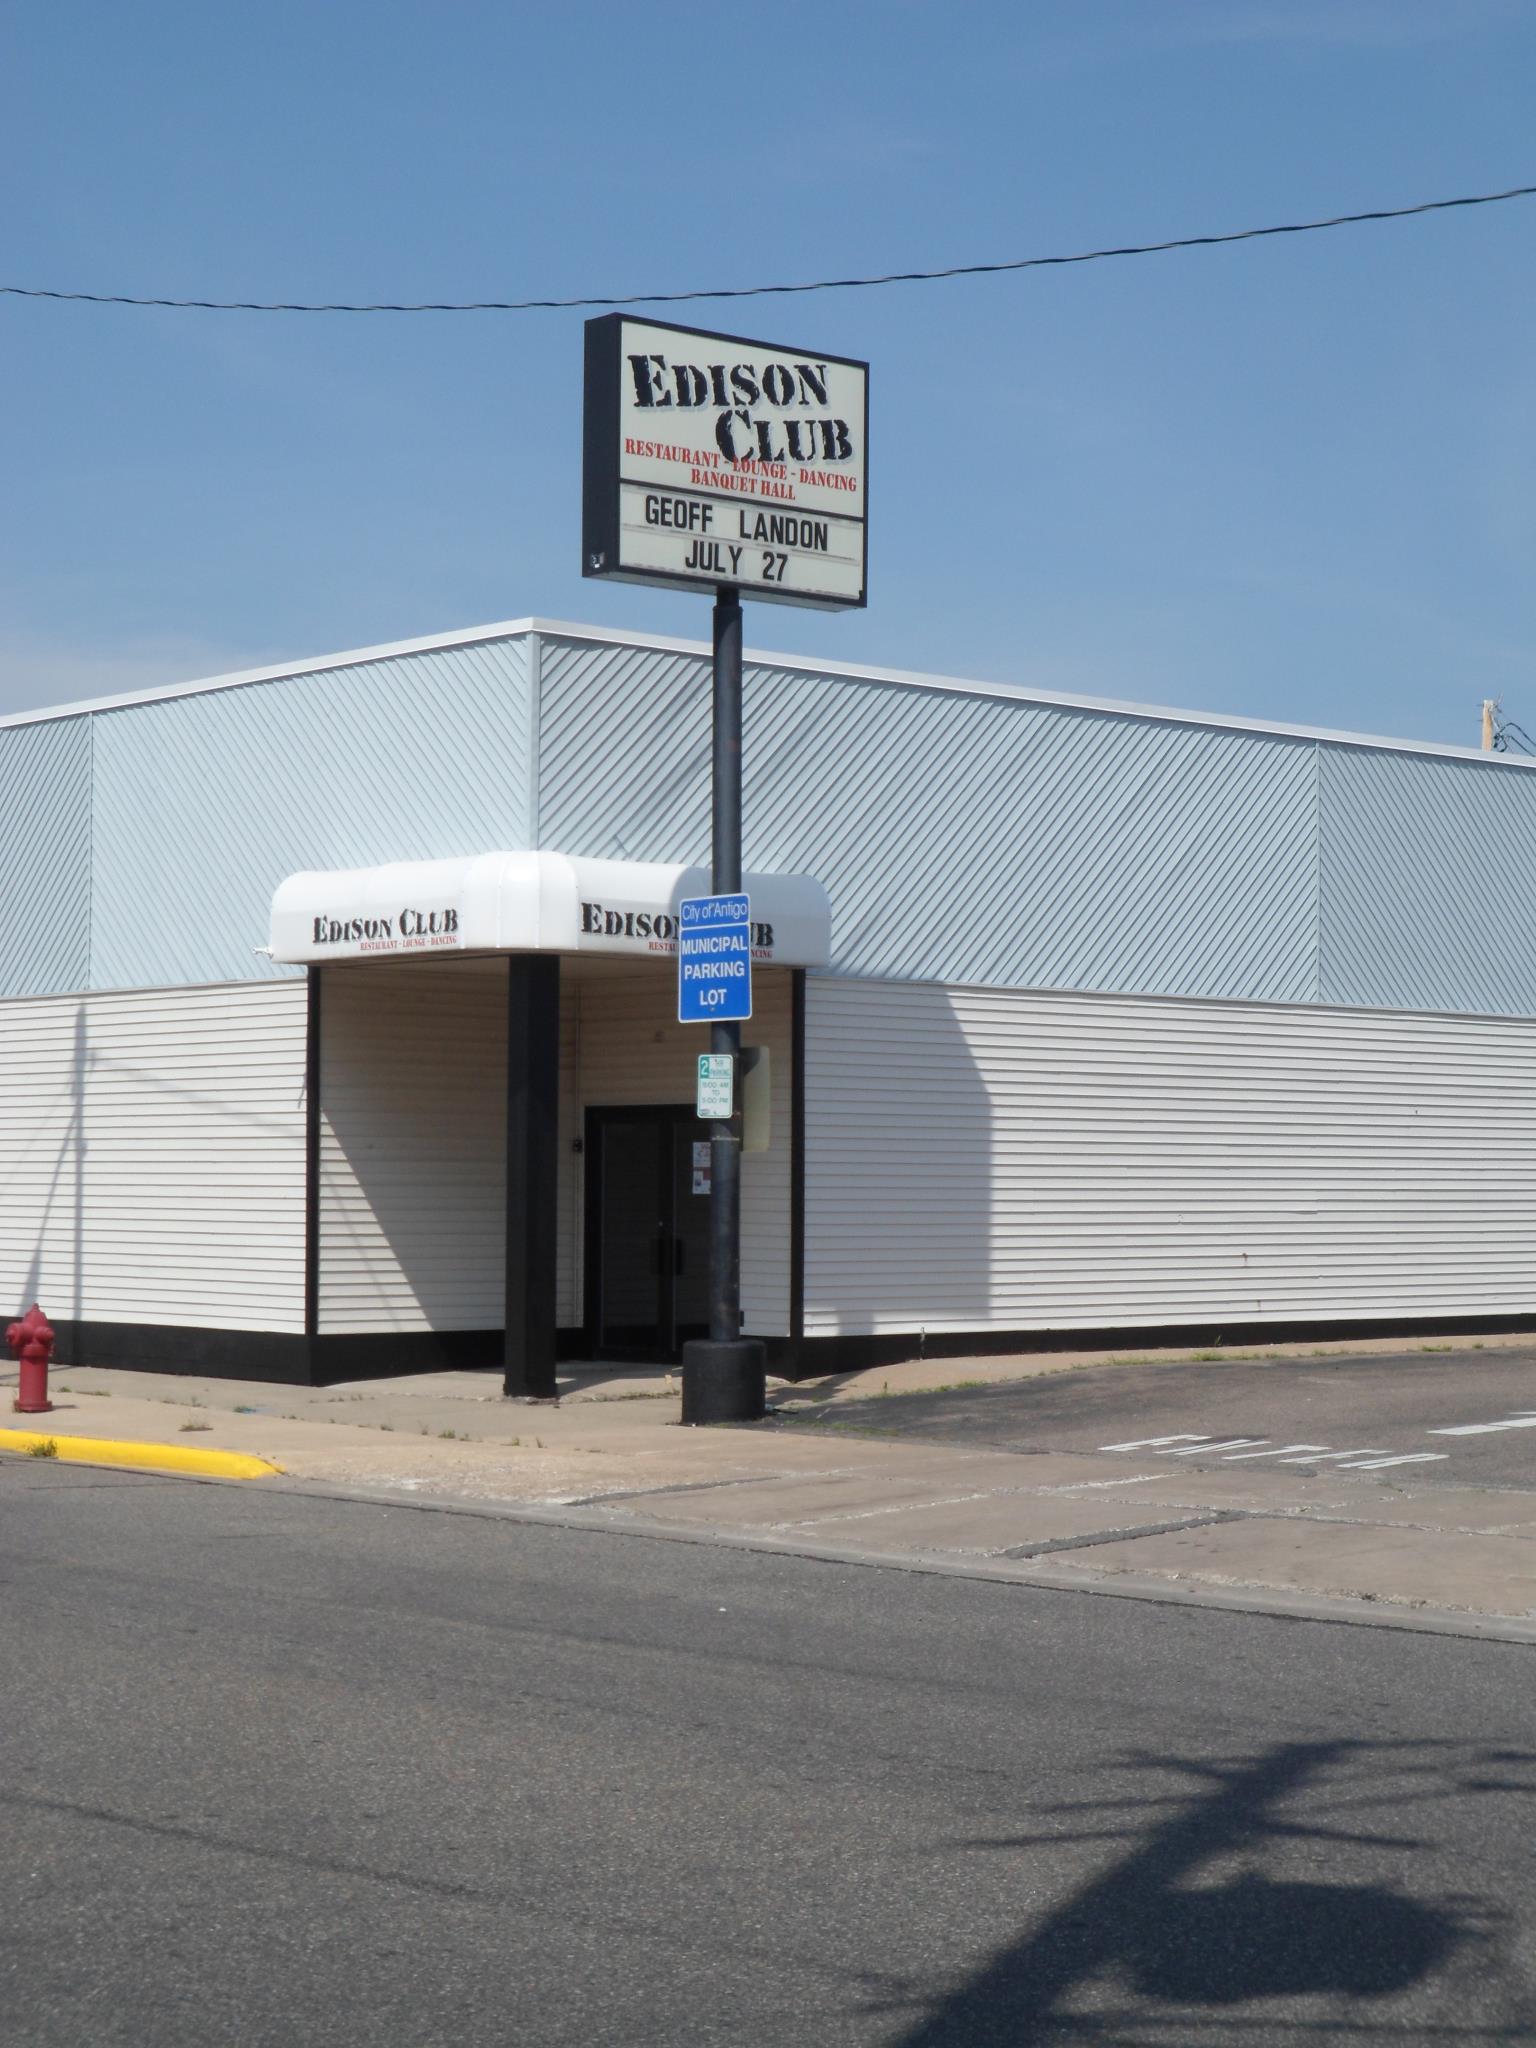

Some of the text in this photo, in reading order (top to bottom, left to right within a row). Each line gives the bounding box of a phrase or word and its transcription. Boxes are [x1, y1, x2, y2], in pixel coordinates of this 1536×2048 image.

[627, 355, 828, 408] EDISON
[715, 409, 853, 463] CLUB
[625, 438, 721, 469] RESTAURANT
[733, 456, 788, 480] LOUNGE
[799, 468, 857, 492] DANCING
[691, 468, 796, 500] BANQUET HALL
[645, 495, 828, 551] GEOFF LANDON
[685, 540, 788, 581] JULY 27
[313, 908, 458, 943] EDISON CLUB
[682, 901, 747, 922] City of Antigo
[682, 935, 748, 955] MUNICIPAL
[684, 961, 745, 980] PARKING
[700, 989, 727, 1006] LOT
[701, 1060, 708, 1076] 2
[1097, 1434, 1450, 1470] ENTER
